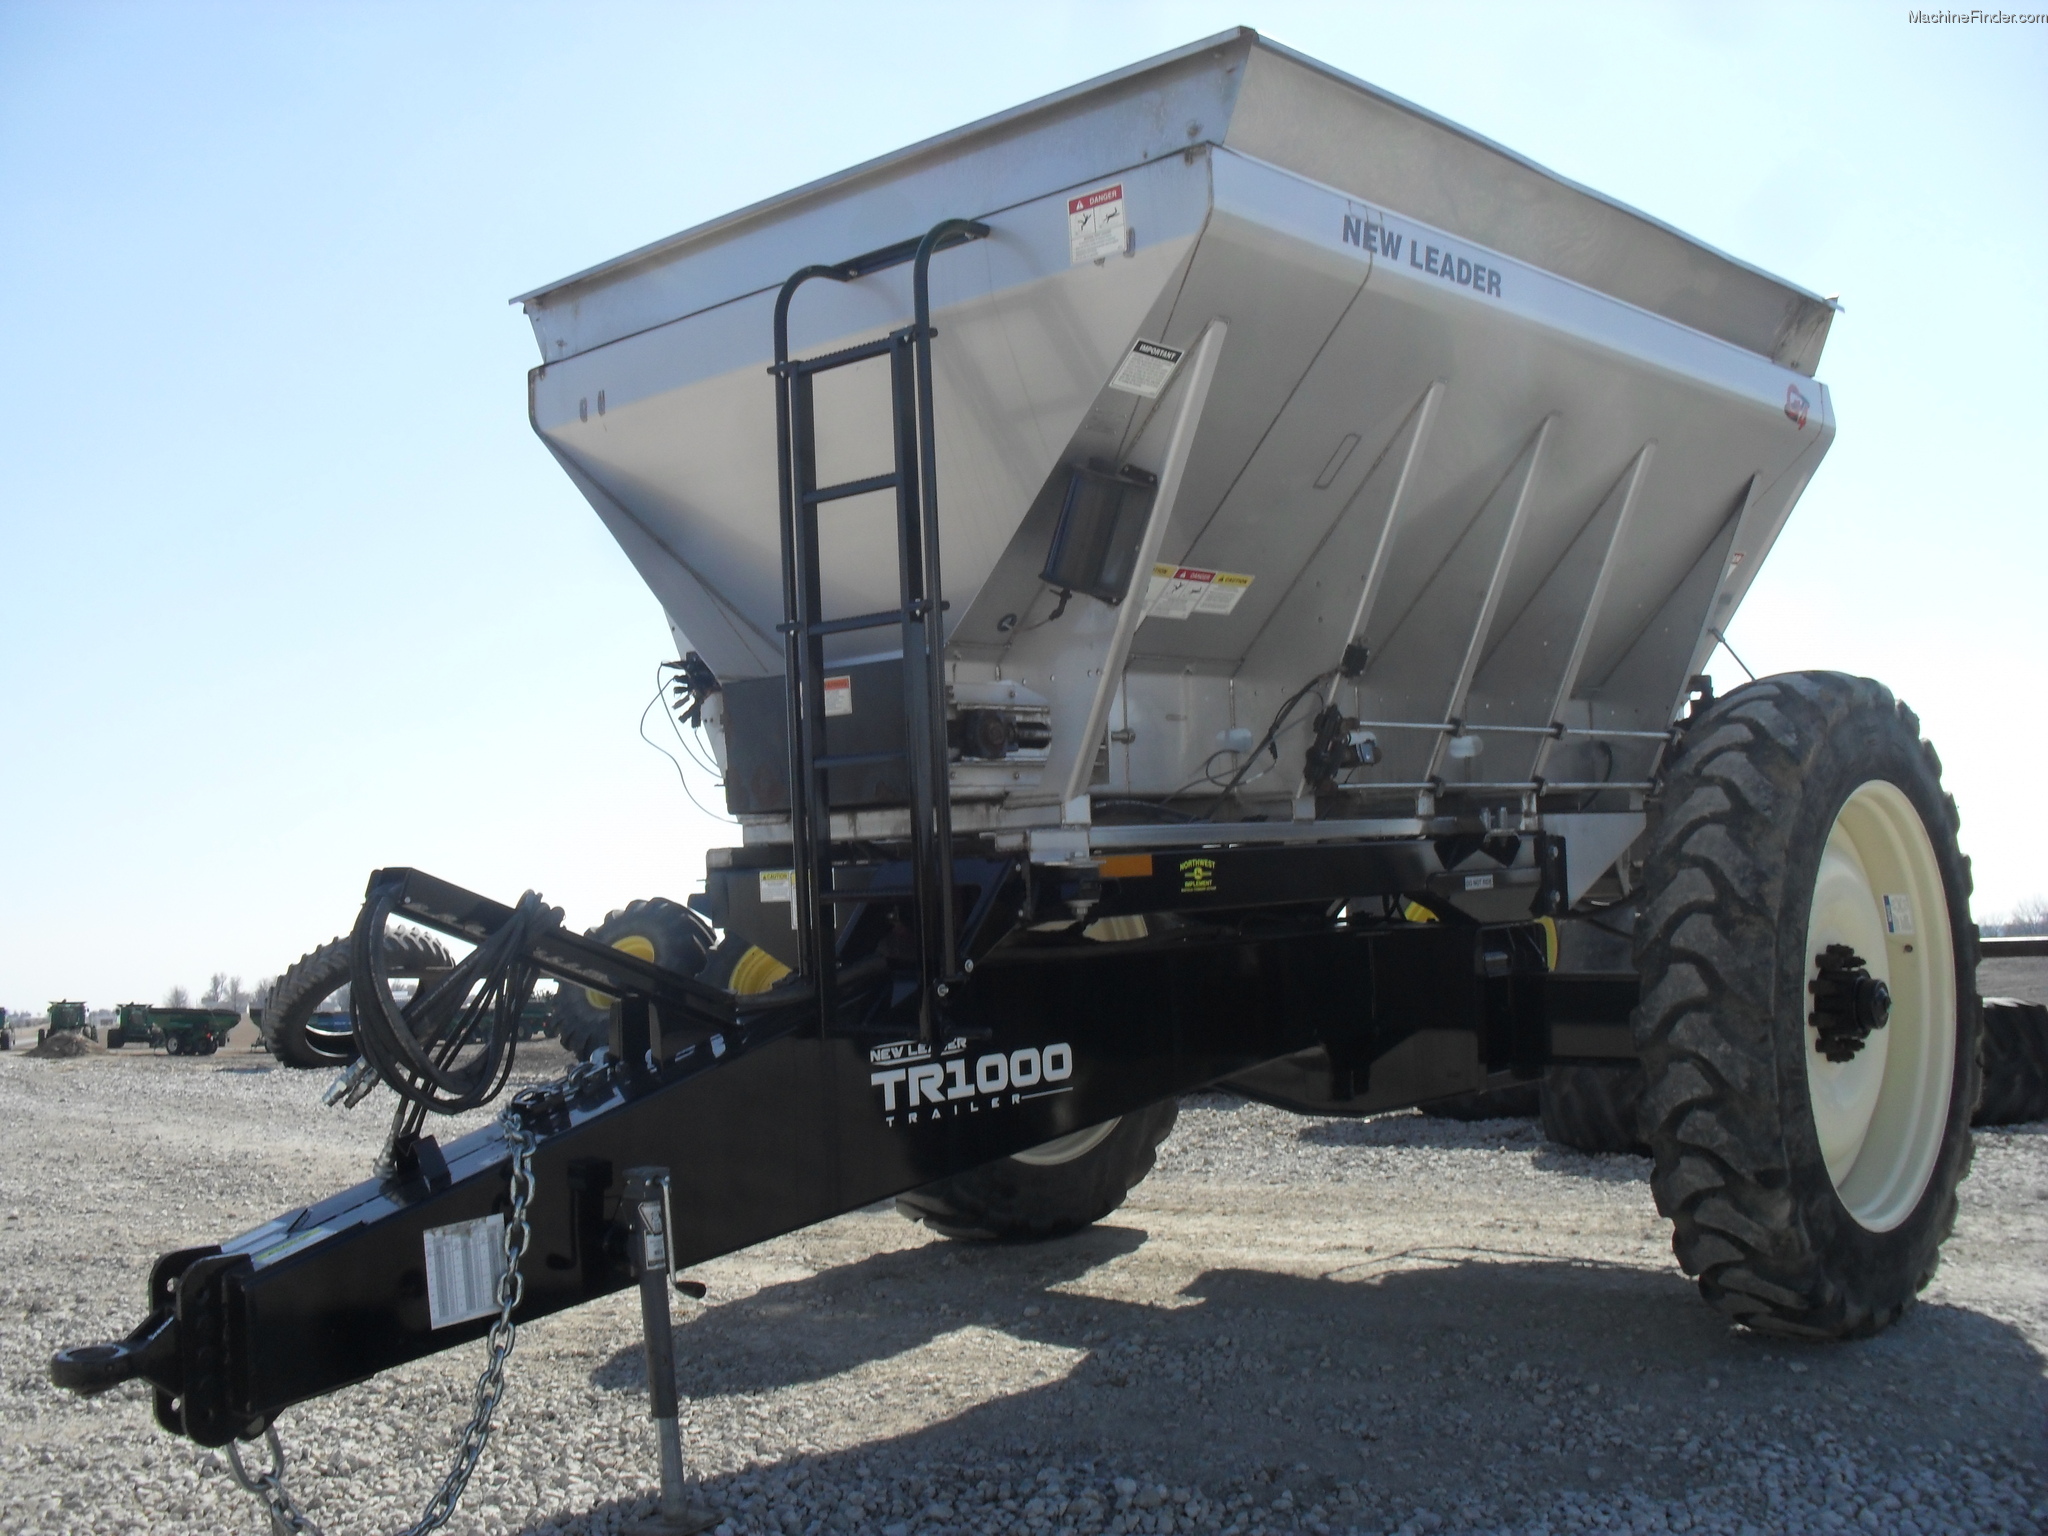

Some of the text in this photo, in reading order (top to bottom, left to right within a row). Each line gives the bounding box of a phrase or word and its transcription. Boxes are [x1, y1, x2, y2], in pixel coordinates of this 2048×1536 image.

[1089, 189, 1117, 206] DANGER
[1342, 214, 1502, 298] NEW LEADER
[1139, 343, 1177, 361] IMPORTANT
[1180, 859, 1215, 871] NORTHWEST
[870, 1036, 967, 1063] NEW LEER
[870, 1042, 1073, 1112] TR1000
[886, 1093, 1021, 1128] TRAILER
